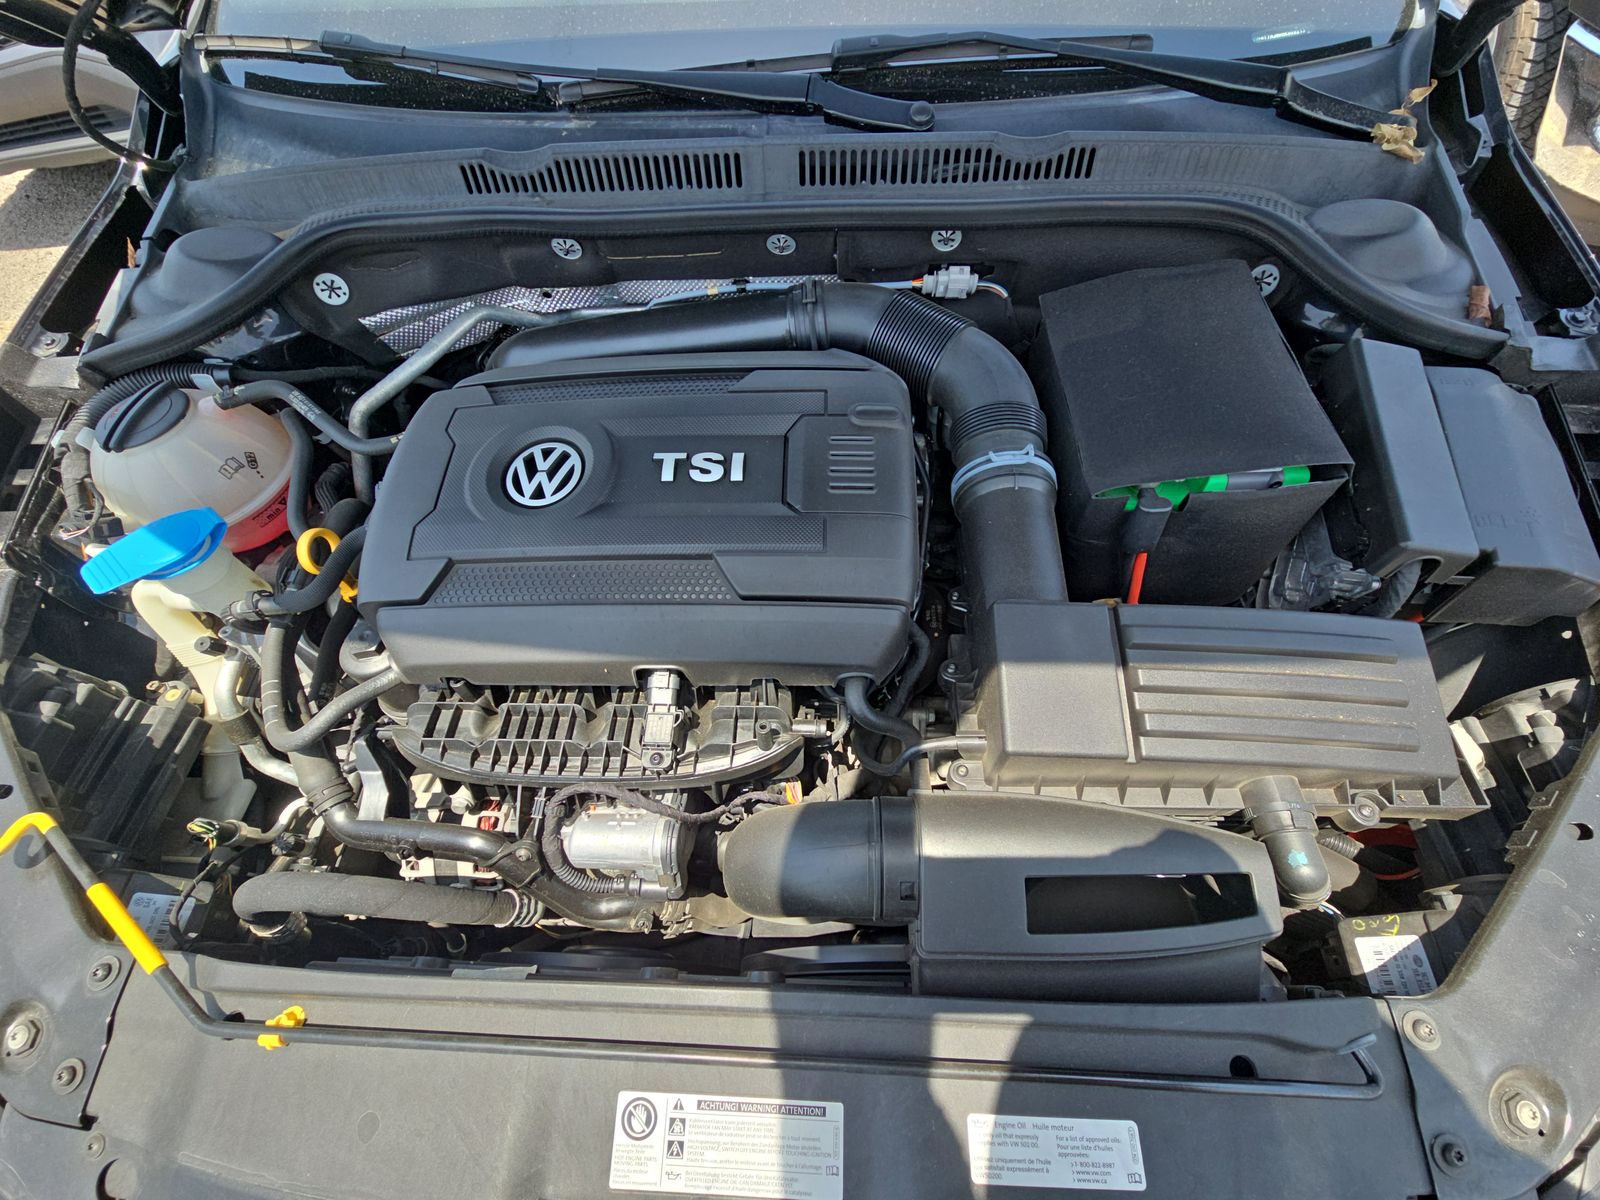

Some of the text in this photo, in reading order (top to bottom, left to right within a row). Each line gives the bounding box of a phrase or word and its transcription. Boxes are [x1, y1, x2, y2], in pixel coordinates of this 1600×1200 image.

[652, 451, 745, 483] TSI
[266, 507, 281, 521] min
[699, 1100, 824, 1117] ACHTUNG! WARNING! ATTENTION!
[1032, 1122, 1050, 1131] Huile
[1051, 1124, 1075, 1132] moteur
[1003, 1132, 1014, 1140] that
[1015, 1134, 1039, 1142] expressly
[994, 1157, 1027, 1166] uniquement
[1036, 1158, 1051, 1166] l'huile
